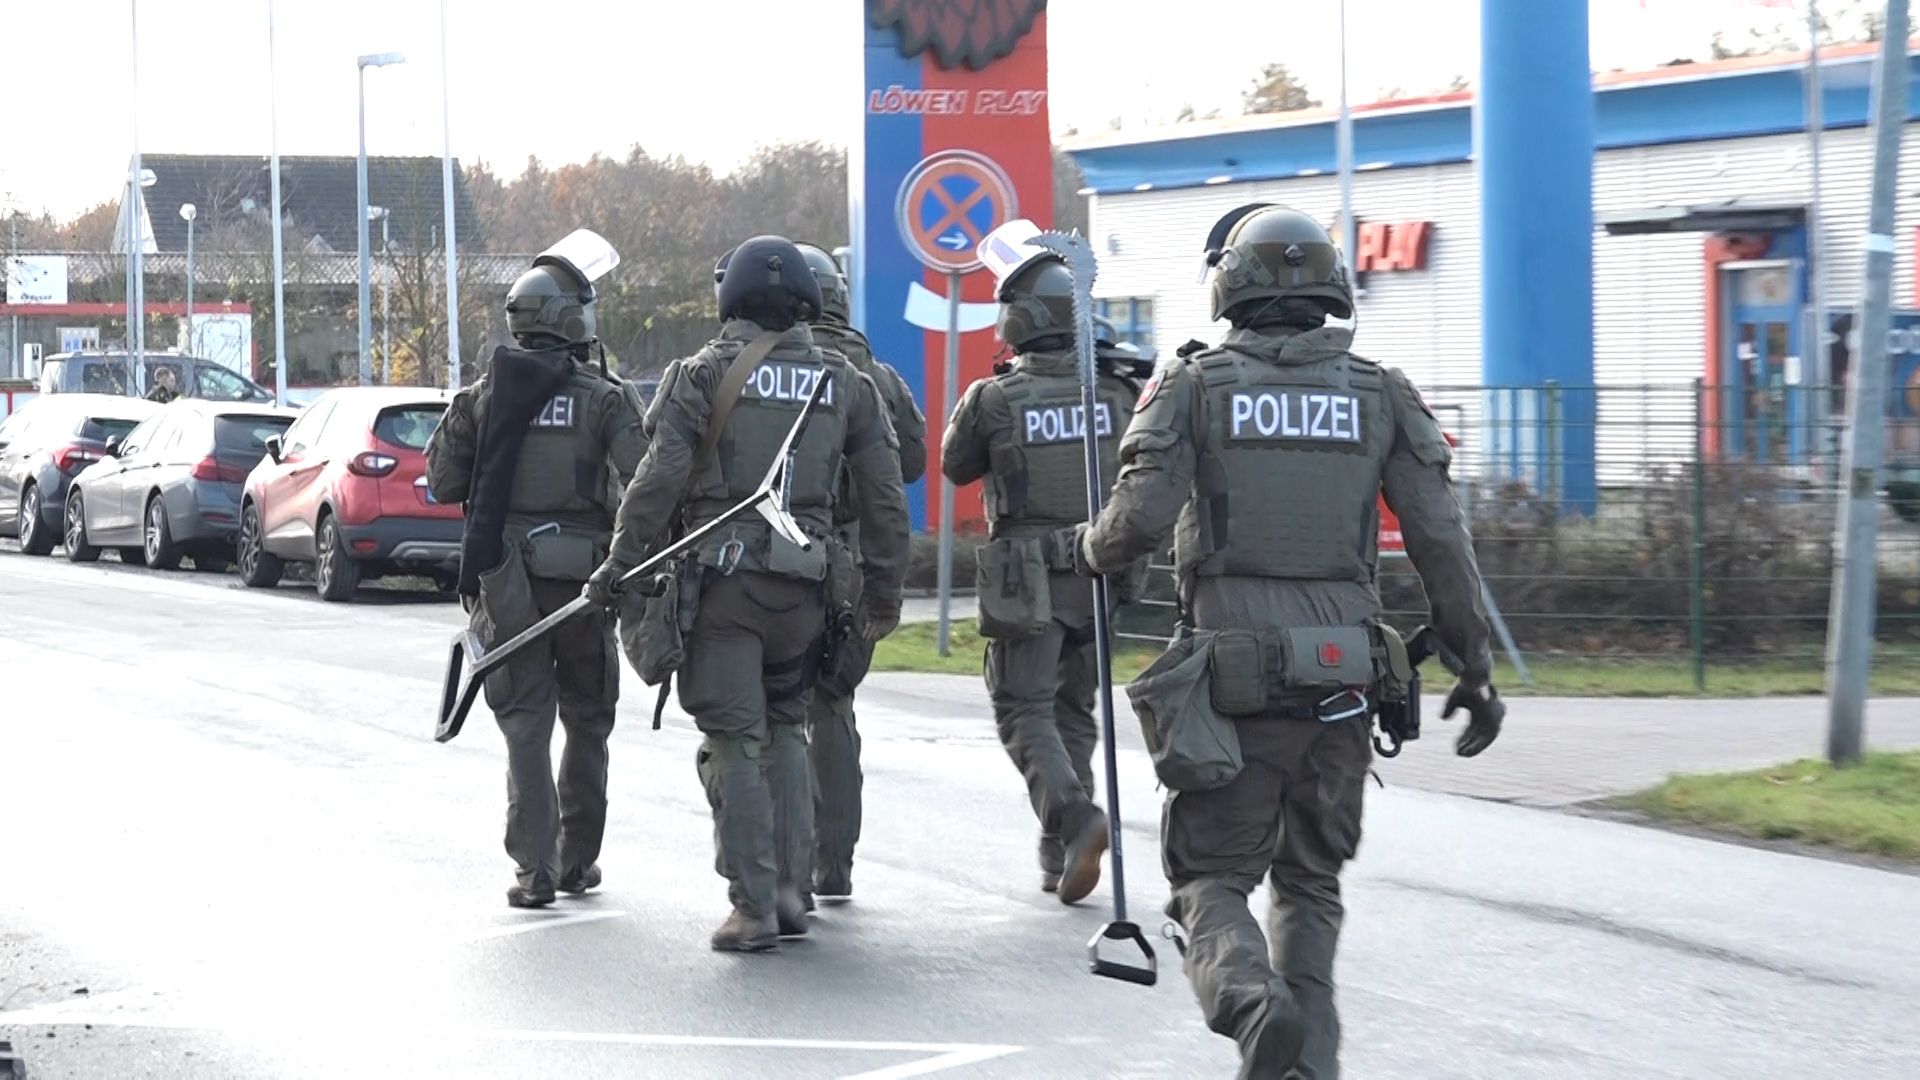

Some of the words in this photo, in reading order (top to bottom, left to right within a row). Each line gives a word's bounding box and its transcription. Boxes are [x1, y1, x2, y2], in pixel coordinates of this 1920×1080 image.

[867, 85, 968, 114] LÖWEN
[973, 90, 1048, 114] PLAY
[1232, 392, 1360, 440] POLIZEI
